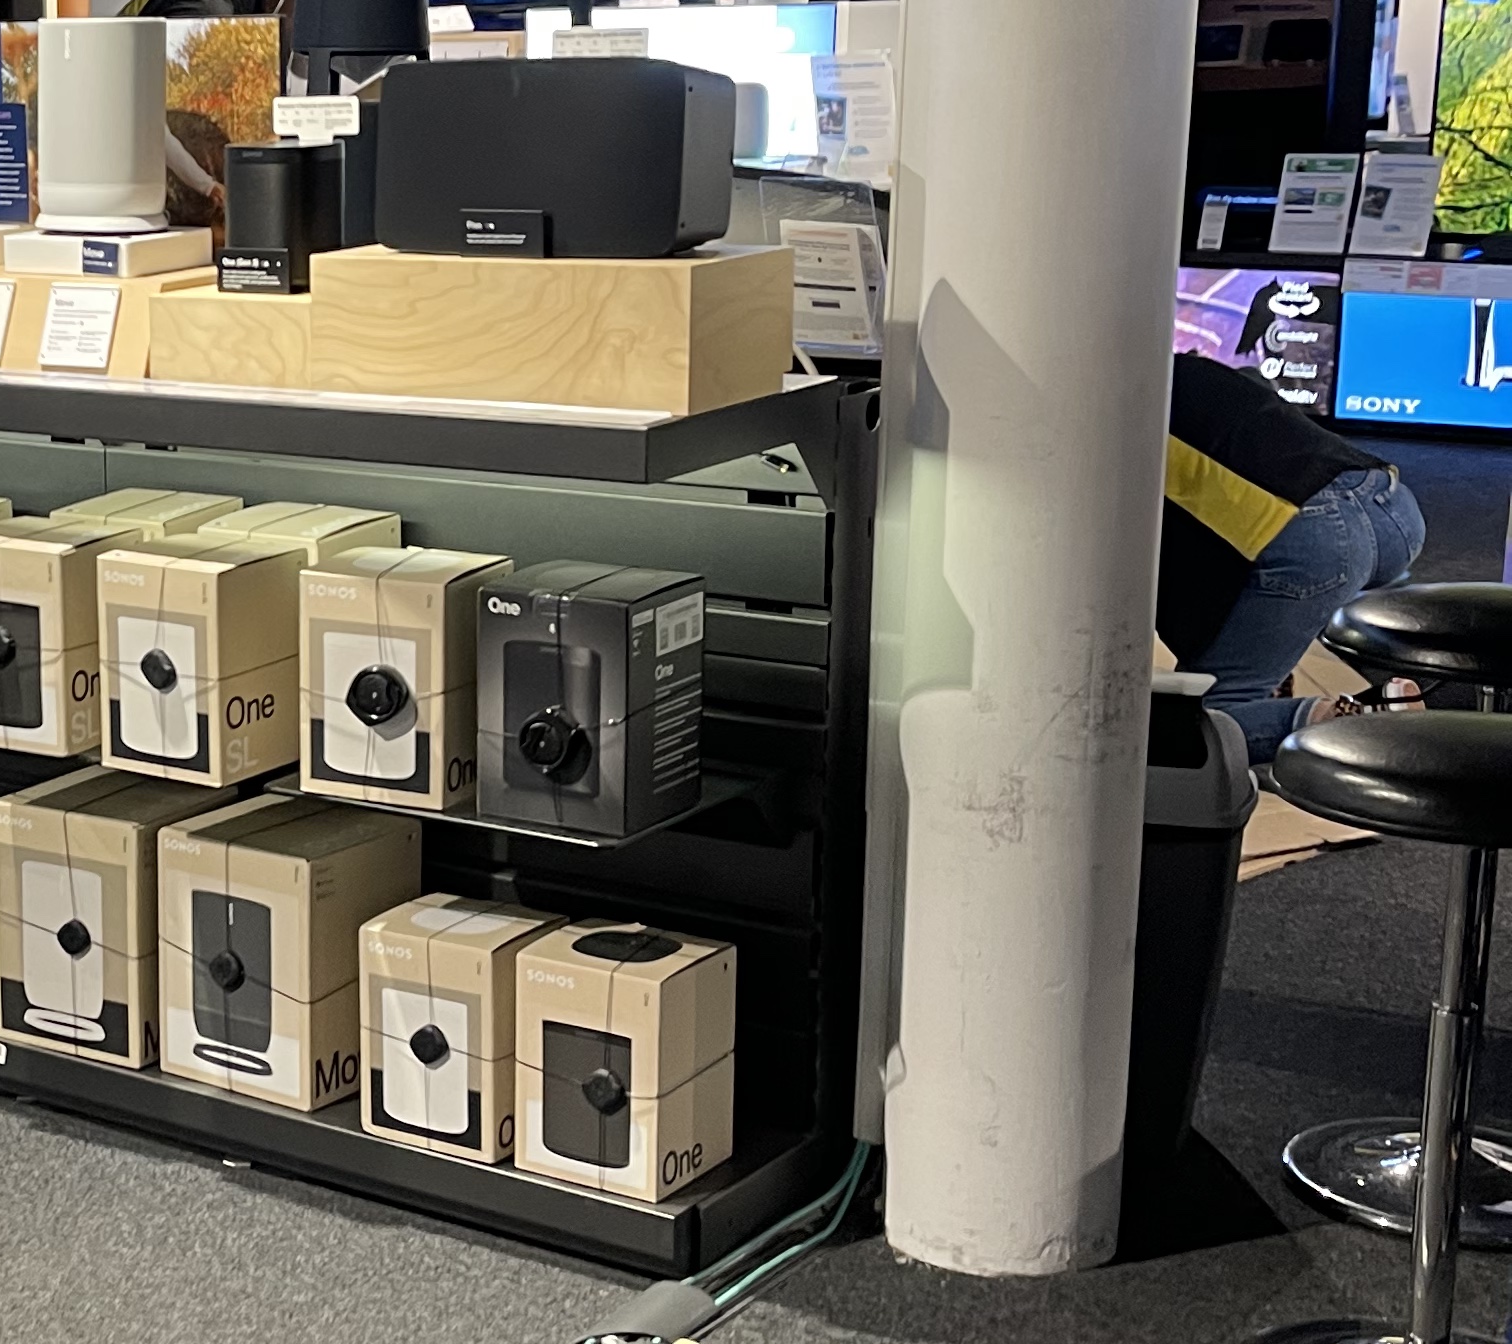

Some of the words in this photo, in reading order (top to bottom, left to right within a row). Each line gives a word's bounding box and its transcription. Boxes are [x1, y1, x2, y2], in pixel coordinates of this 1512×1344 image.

[1345, 395, 1422, 415] SONY
[104, 570, 145, 587] SONOS
[307, 583, 358, 601] SONOS
[487, 596, 522, 617] One
[71, 669, 100, 702] On
[226, 692, 276, 730] One
[225, 736, 259, 774] SL
[447, 757, 474, 793] On
[163, 837, 202, 856] SONOS
[367, 940, 413, 960] SONOS
[526, 968, 576, 990] SONOS
[314, 1049, 360, 1099] Mo
[661, 1141, 704, 1186] One
